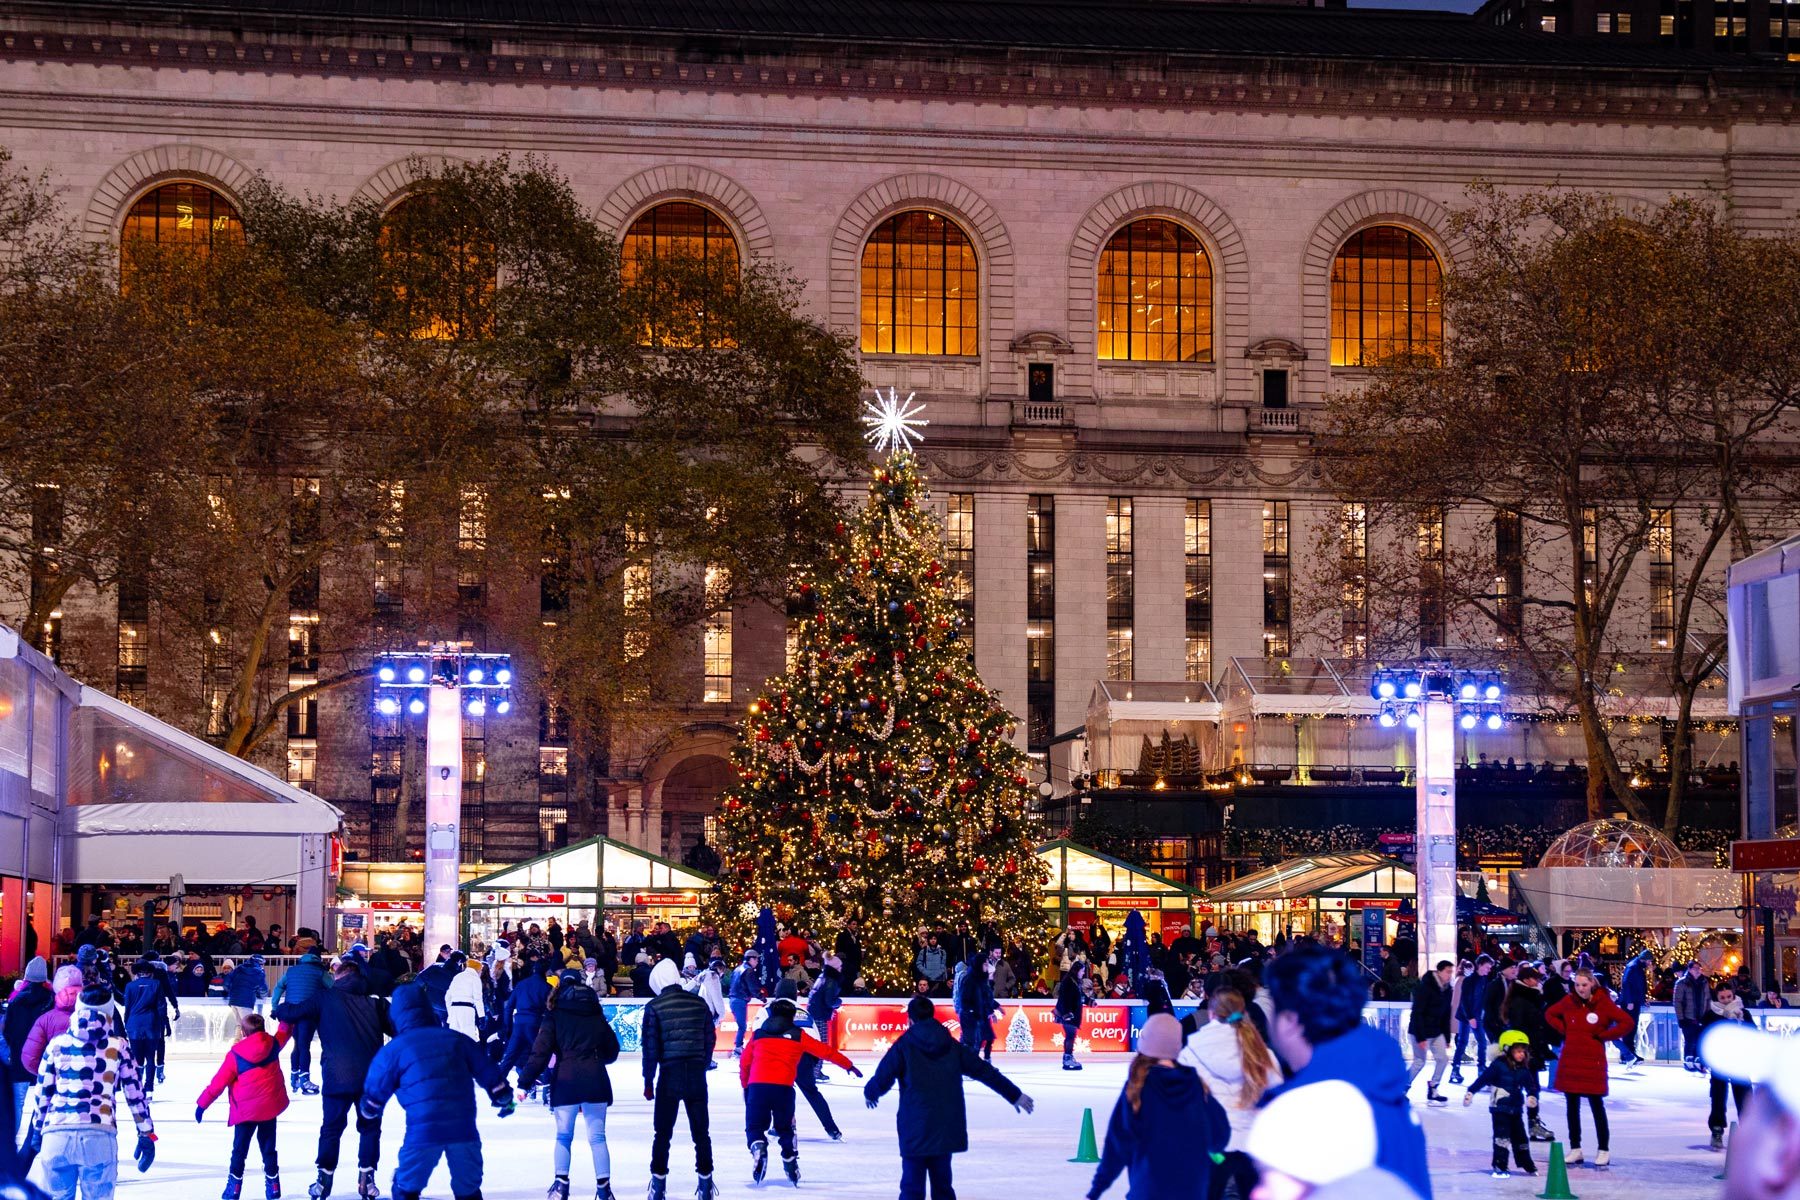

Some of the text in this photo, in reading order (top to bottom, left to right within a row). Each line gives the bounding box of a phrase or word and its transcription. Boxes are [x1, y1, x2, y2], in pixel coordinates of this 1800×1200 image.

[1086, 1009, 1119, 1023] hour
[851, 1023, 878, 1031] BANK
[880, 1023, 894, 1031] OF
[1091, 1027, 1128, 1042] every
